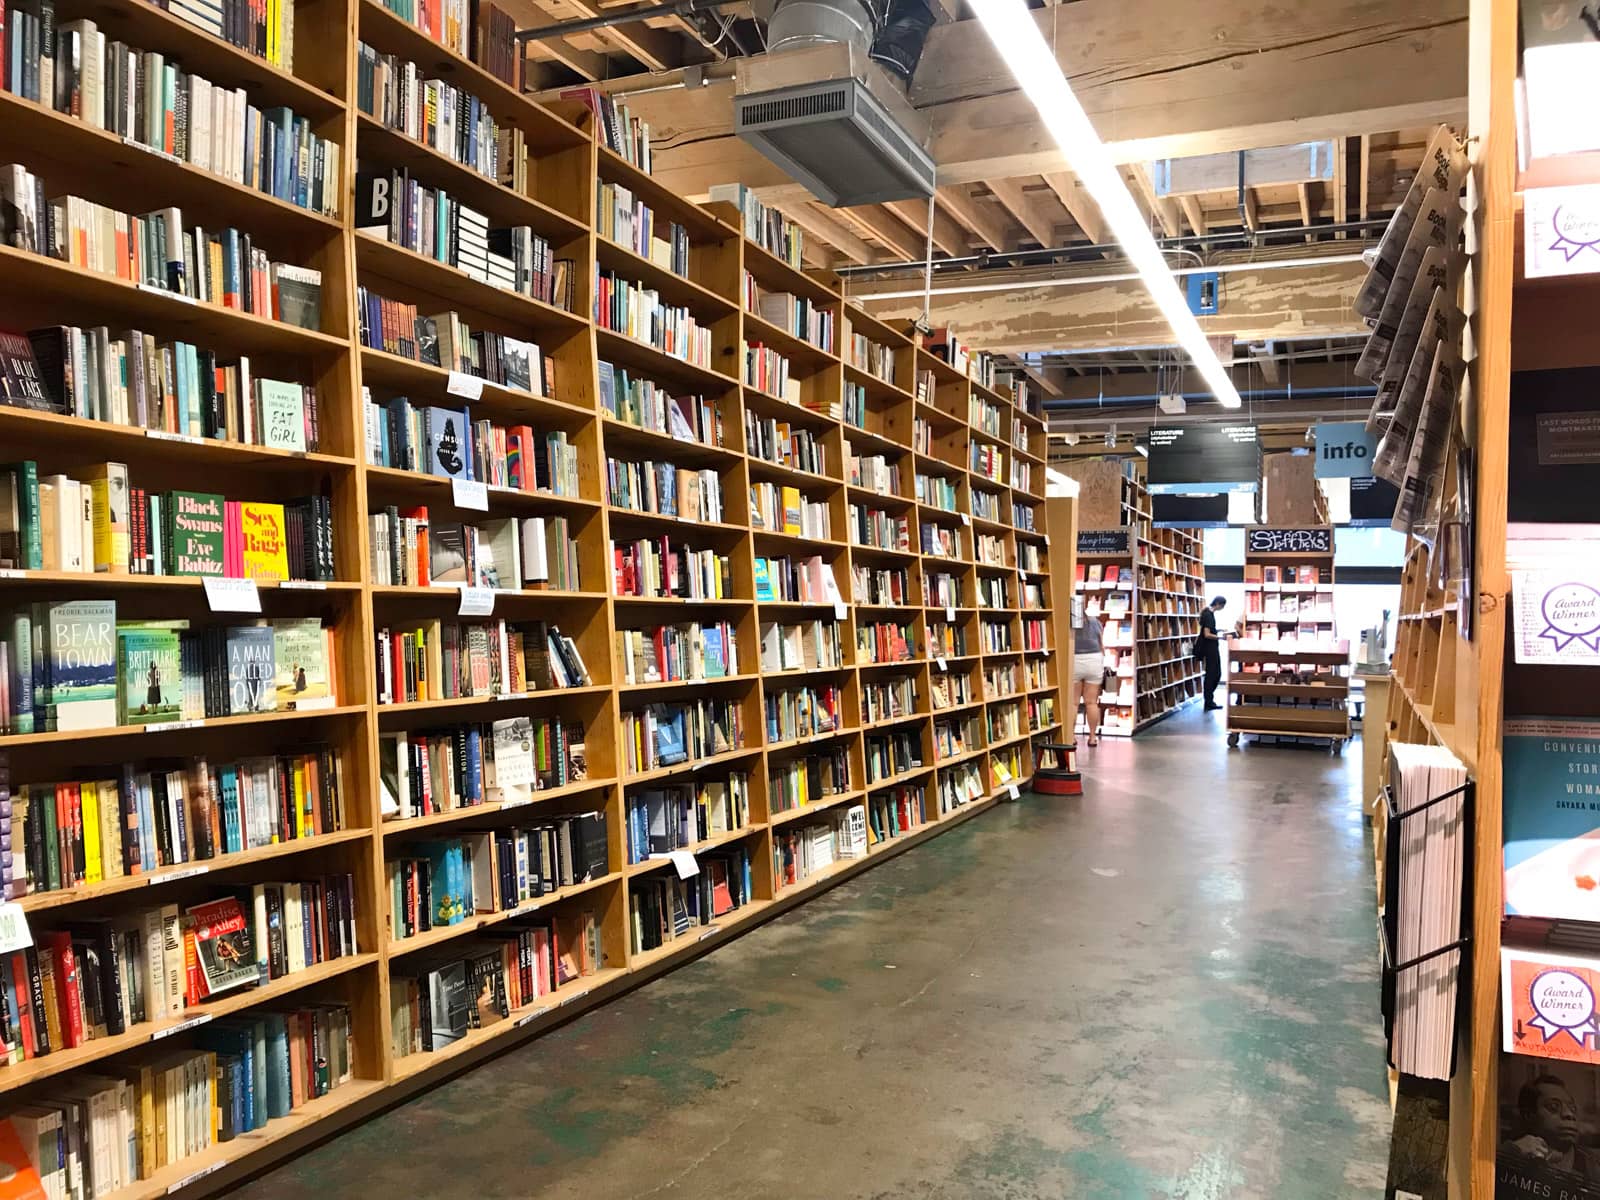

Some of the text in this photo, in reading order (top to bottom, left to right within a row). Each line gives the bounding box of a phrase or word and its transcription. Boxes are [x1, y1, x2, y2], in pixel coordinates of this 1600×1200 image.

[371, 177, 389, 218] B
[11, 358, 38, 379] BLUE
[19, 379, 46, 399] FACE
[272, 410, 294, 426] FAT
[434, 433, 463, 446] CENSUS
[1323, 442, 1367, 460] info
[178, 496, 220, 517] Black
[175, 514, 223, 533] Swans
[245, 507, 279, 530] Sex
[187, 538, 214, 556] Eve
[242, 532, 285, 556] Rage
[1252, 530, 1326, 550] Staff Picks
[178, 555, 223, 574] Babitz
[1555, 596, 1597, 609] Award
[1552, 609, 1596, 620] Winner
[55, 622, 112, 648] BEAR
[55, 647, 112, 671] TOWN
[232, 645, 271, 662] A MAN
[232, 662, 273, 680] CALLED
[23, 678, 31, 711] BEARTOWN
[1556, 800, 1586, 810] SAYAKA
[194, 908, 239, 926] Paradise
[213, 917, 241, 934] Alley
[234, 967, 253, 979] BAKER
[32, 975, 42, 1006] GRACE
[1543, 986, 1585, 998] Award
[1541, 998, 1584, 1010] Winner
[1500, 1168, 1552, 1198] JAMES
